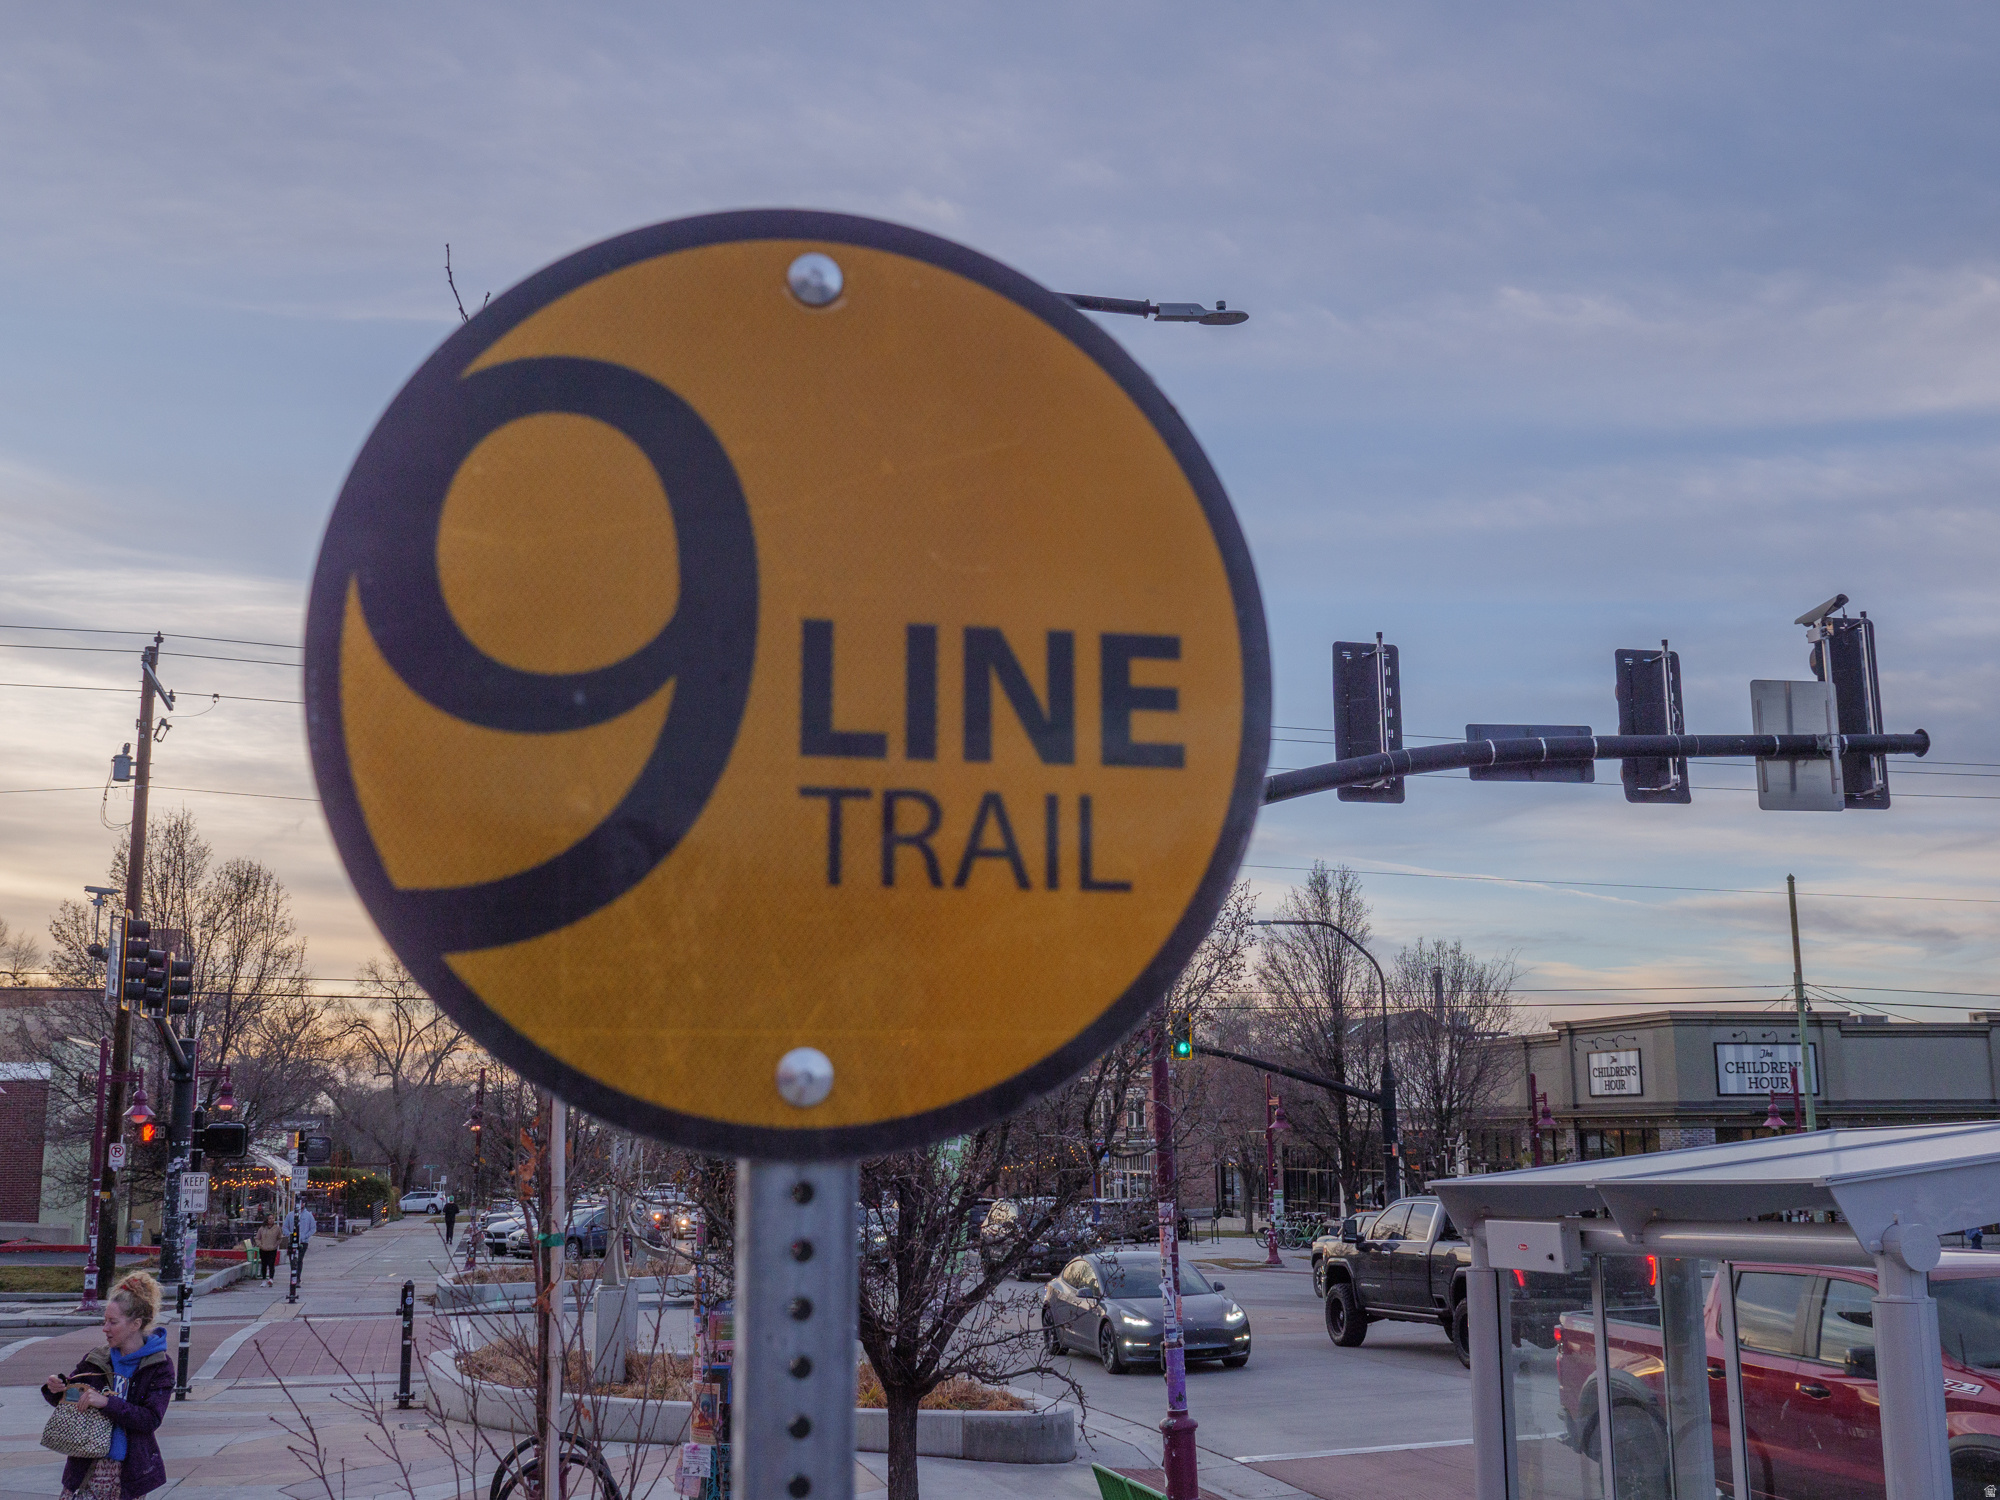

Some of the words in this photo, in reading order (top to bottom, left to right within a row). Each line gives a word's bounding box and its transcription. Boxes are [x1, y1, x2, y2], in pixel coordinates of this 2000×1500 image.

[345, 355, 760, 956] 9
[799, 618, 1186, 769] LINE
[798, 786, 1132, 894] TRAIL
[1760, 1049, 1773, 1058] The
[1592, 1065, 1637, 1077] CHILDREN'S
[1604, 1079, 1626, 1090] HOUR
[1748, 1077, 1789, 1089] HOUR
[184, 1176, 205, 1187] KEEP
